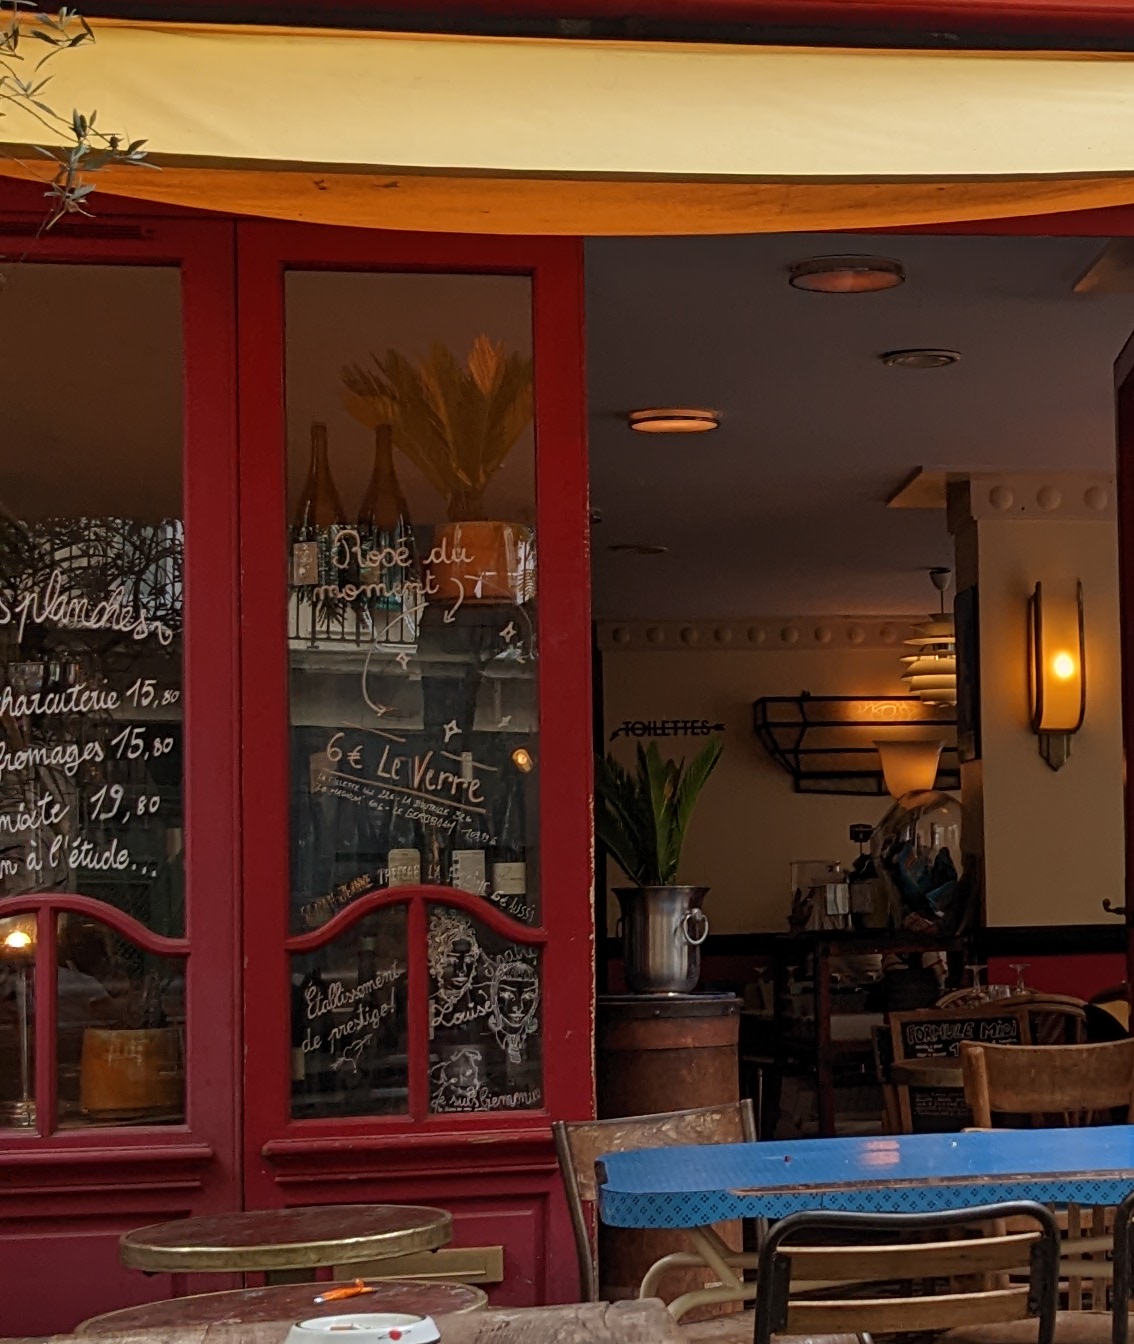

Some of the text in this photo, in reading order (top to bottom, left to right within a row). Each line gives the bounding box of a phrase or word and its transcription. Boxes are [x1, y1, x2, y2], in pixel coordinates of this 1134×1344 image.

[0, 677, 180, 717] harcuterie 15,80
[111, 725, 174, 761] 15,80
[622, 719, 711, 737] TOILETTES
[27, 839, 43, 871] à
[906, 1022, 975, 1044] FORMULE
